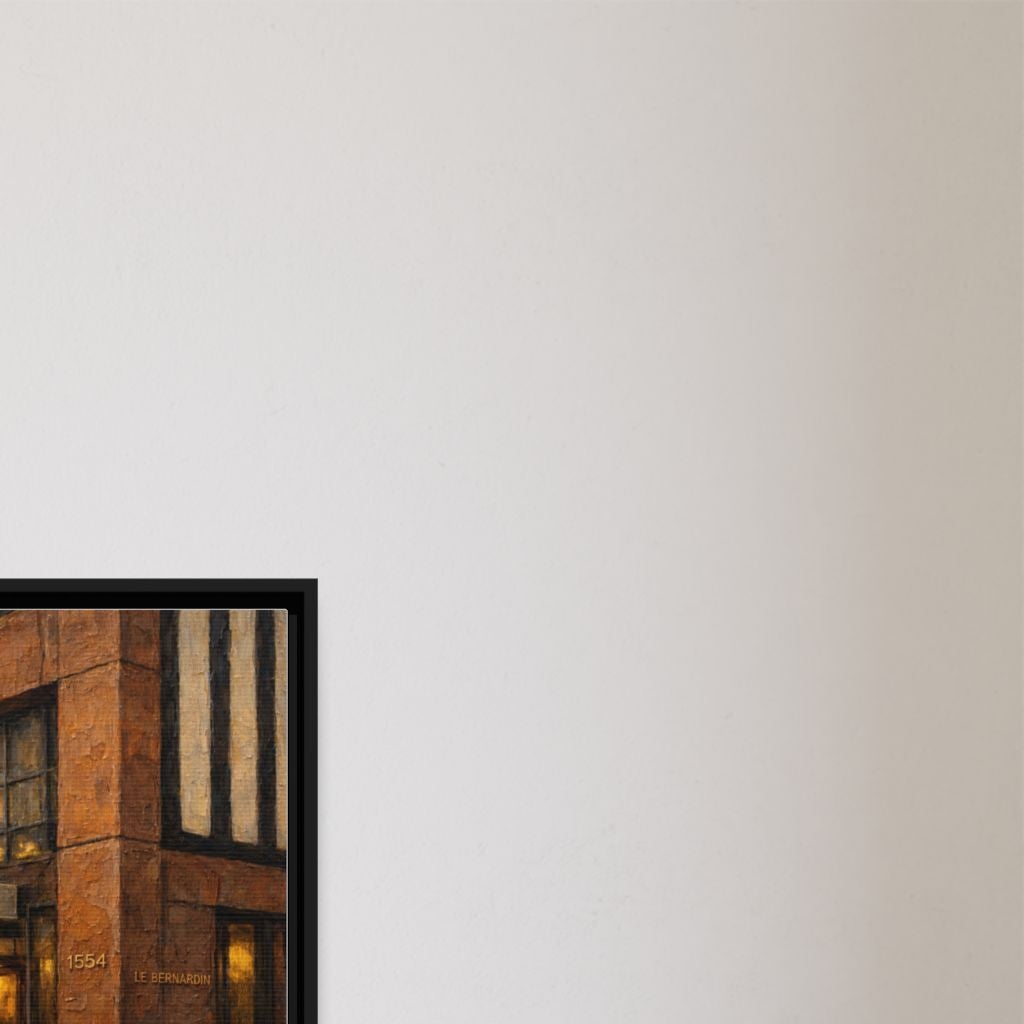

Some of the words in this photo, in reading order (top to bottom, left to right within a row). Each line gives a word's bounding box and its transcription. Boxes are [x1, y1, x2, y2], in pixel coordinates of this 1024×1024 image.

[67, 953, 107, 970] 1554
[134, 971, 147, 984] LE
[151, 972, 211, 986] BERNARDIN
